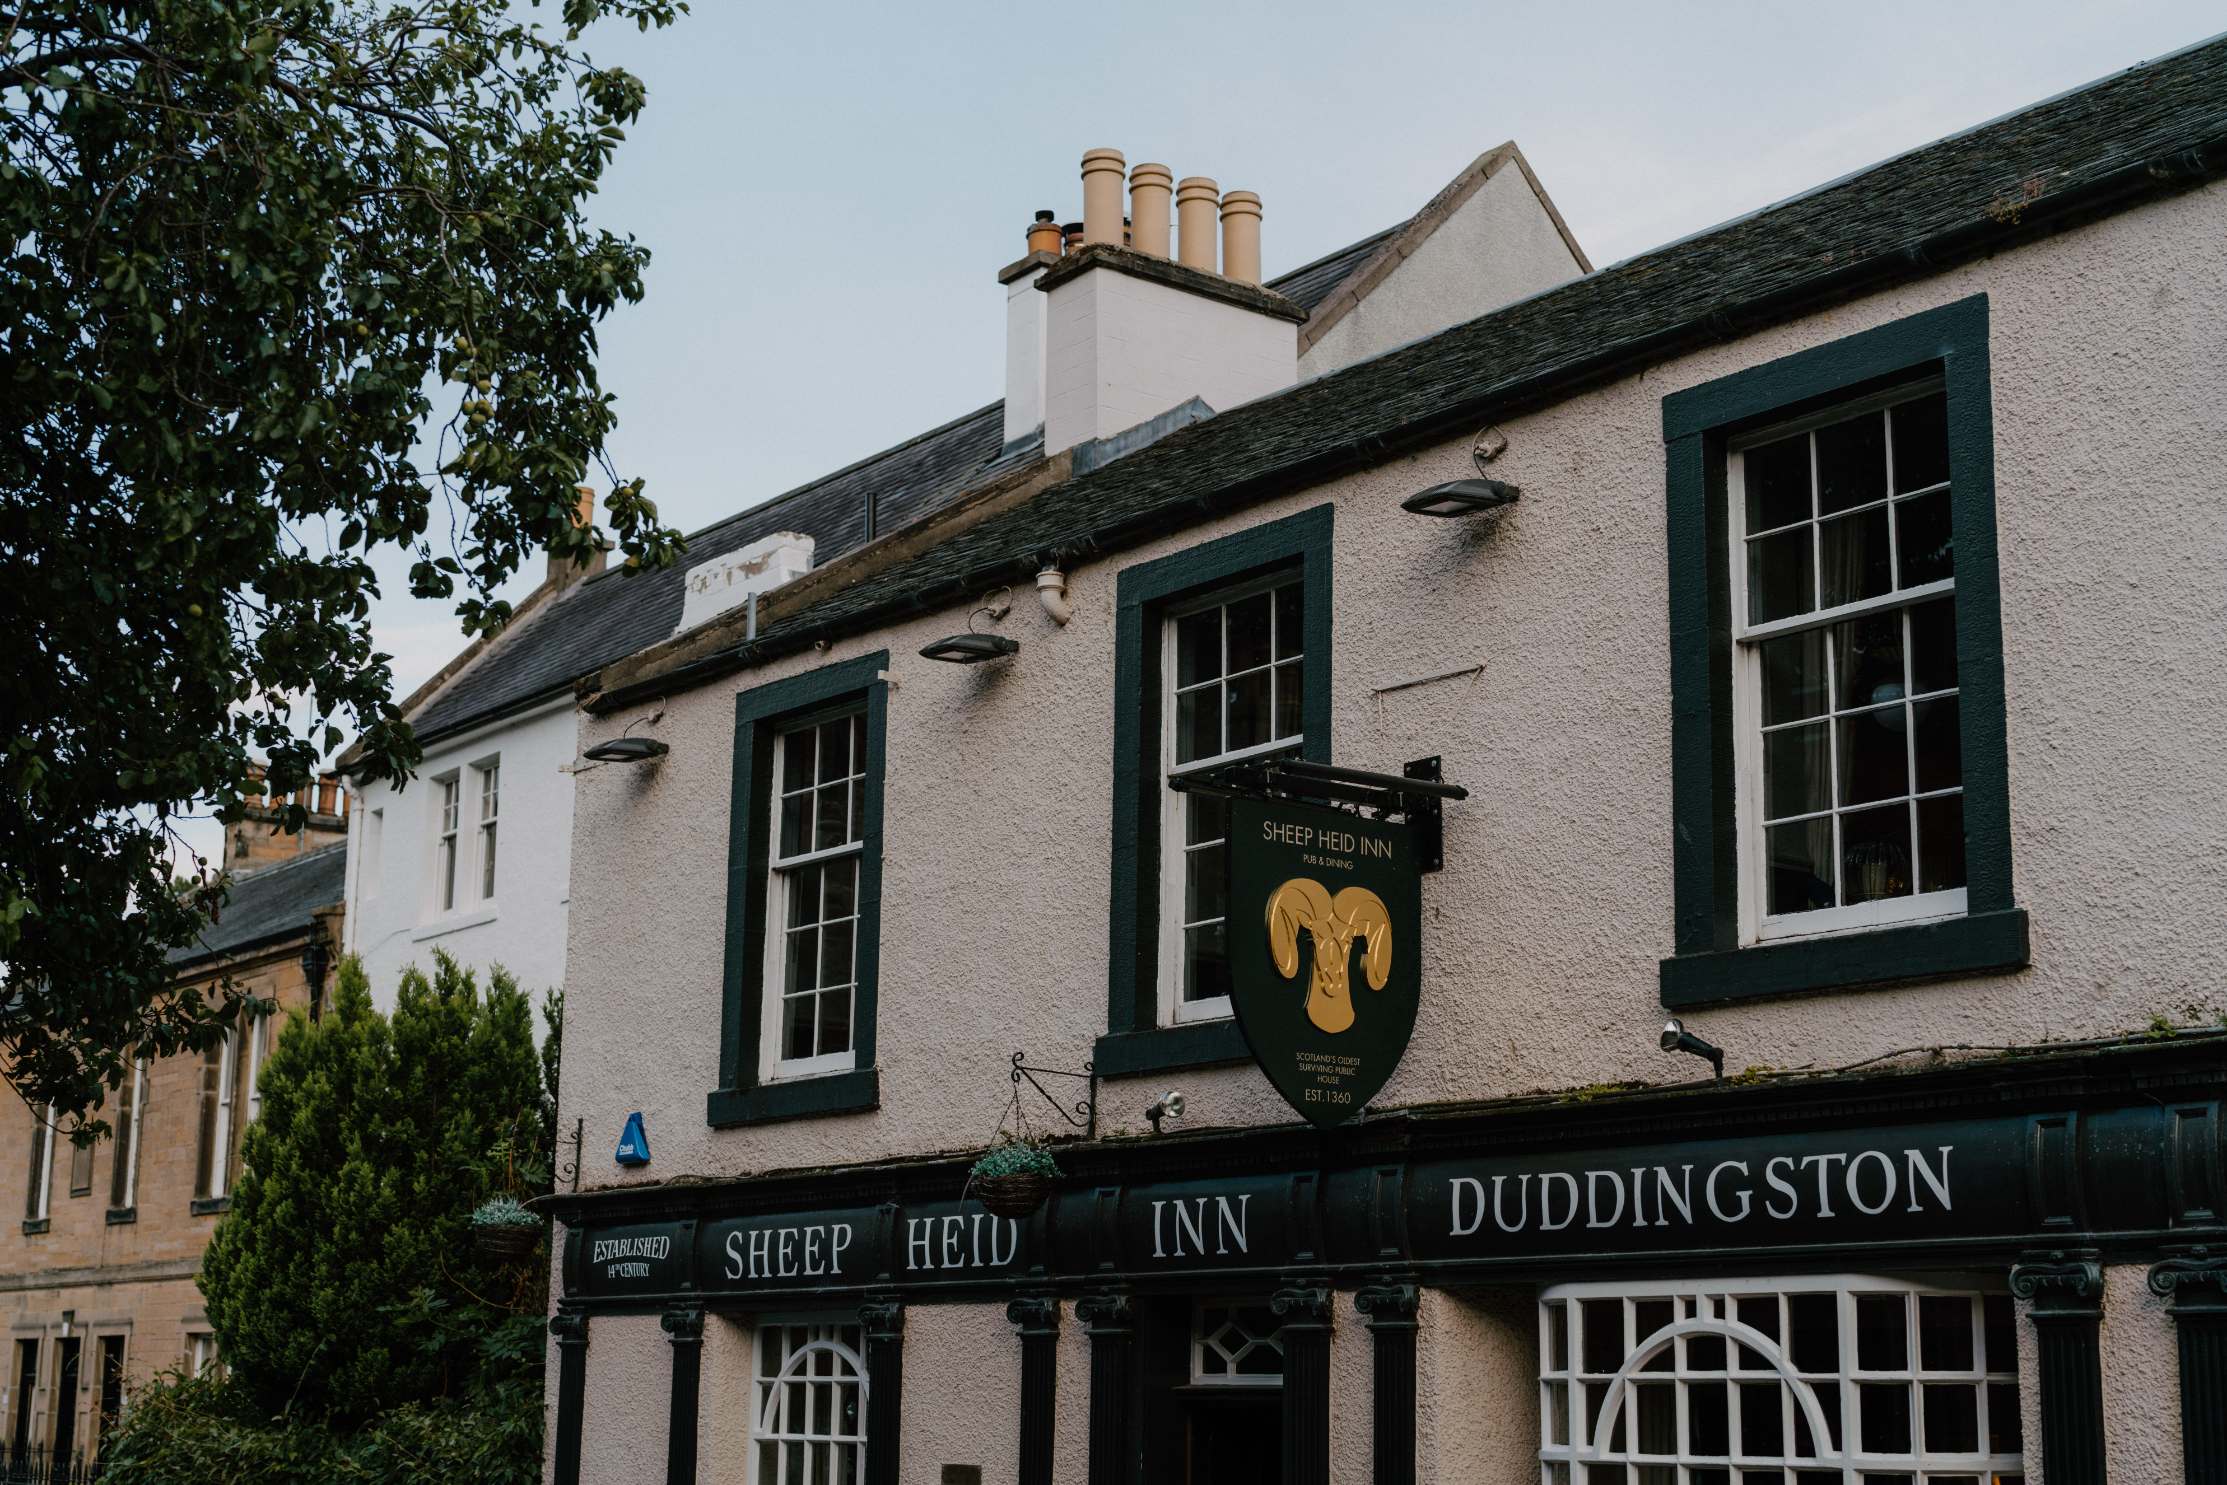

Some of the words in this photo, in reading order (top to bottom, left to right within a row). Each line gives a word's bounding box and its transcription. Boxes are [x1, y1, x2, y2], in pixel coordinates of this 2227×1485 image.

[1263, 820, 1313, 846] SHEEP
[1318, 829, 1355, 853] HEID
[1360, 836, 1392, 860] INN
[1303, 854, 1317, 864] PUB
[1318, 857, 1325, 866] &
[1326, 857, 1354, 870] DINING
[1296, 1052, 1337, 1064] SCOTLAND'S
[1338, 1056, 1360, 1066] OLDEST
[1299, 1062, 1334, 1074] SURVIVING
[1335, 1066, 1356, 1076] PUBLIC
[1317, 1075, 1340, 1084] HOUSE
[1448, 1145, 1954, 1237] DUDDINGSTON
[724, 1223, 852, 1280] SHEEP
[906, 1213, 1018, 1271] HEID
[1151, 1194, 1252, 1258] INN
[592, 1235, 670, 1263] ESTABLISHED
[620, 1262, 650, 1277] CENTURY
